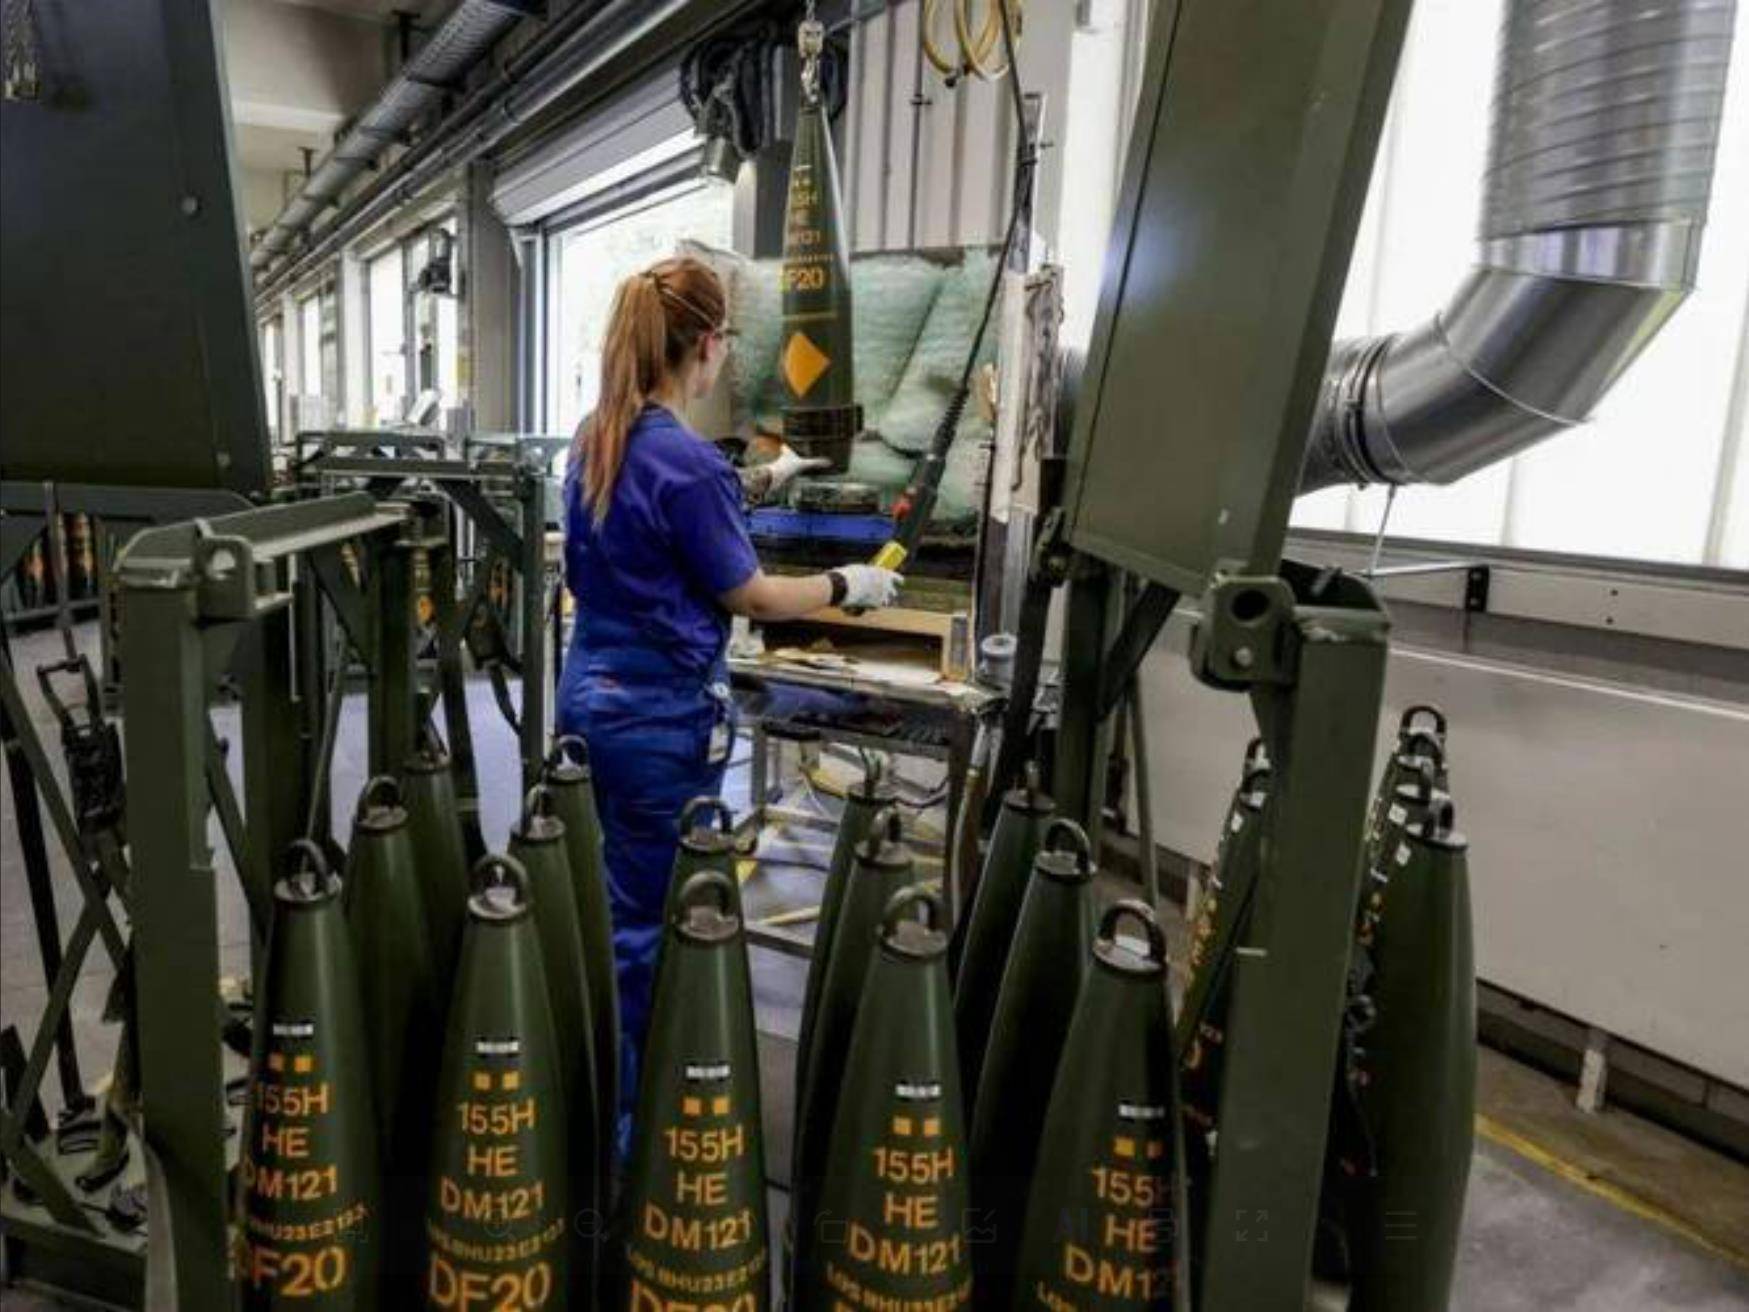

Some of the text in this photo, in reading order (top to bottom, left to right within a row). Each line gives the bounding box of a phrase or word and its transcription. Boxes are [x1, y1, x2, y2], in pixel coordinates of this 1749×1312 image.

[457, 1096, 536, 1135] 155H
[263, 1126, 310, 1158] HE
[664, 1124, 745, 1162] 155H
[467, 1145, 520, 1178] HE
[872, 1147, 954, 1183] 155H
[440, 1176, 544, 1221] DM121
[676, 1169, 729, 1206] HE
[643, 1202, 752, 1251] DM121
[885, 1192, 940, 1229] HE
[849, 1221, 961, 1276] DM121
[1104, 1213, 1160, 1251] HE
[236, 1244, 348, 1298] F20
[429, 1252, 552, 1312] DF20
